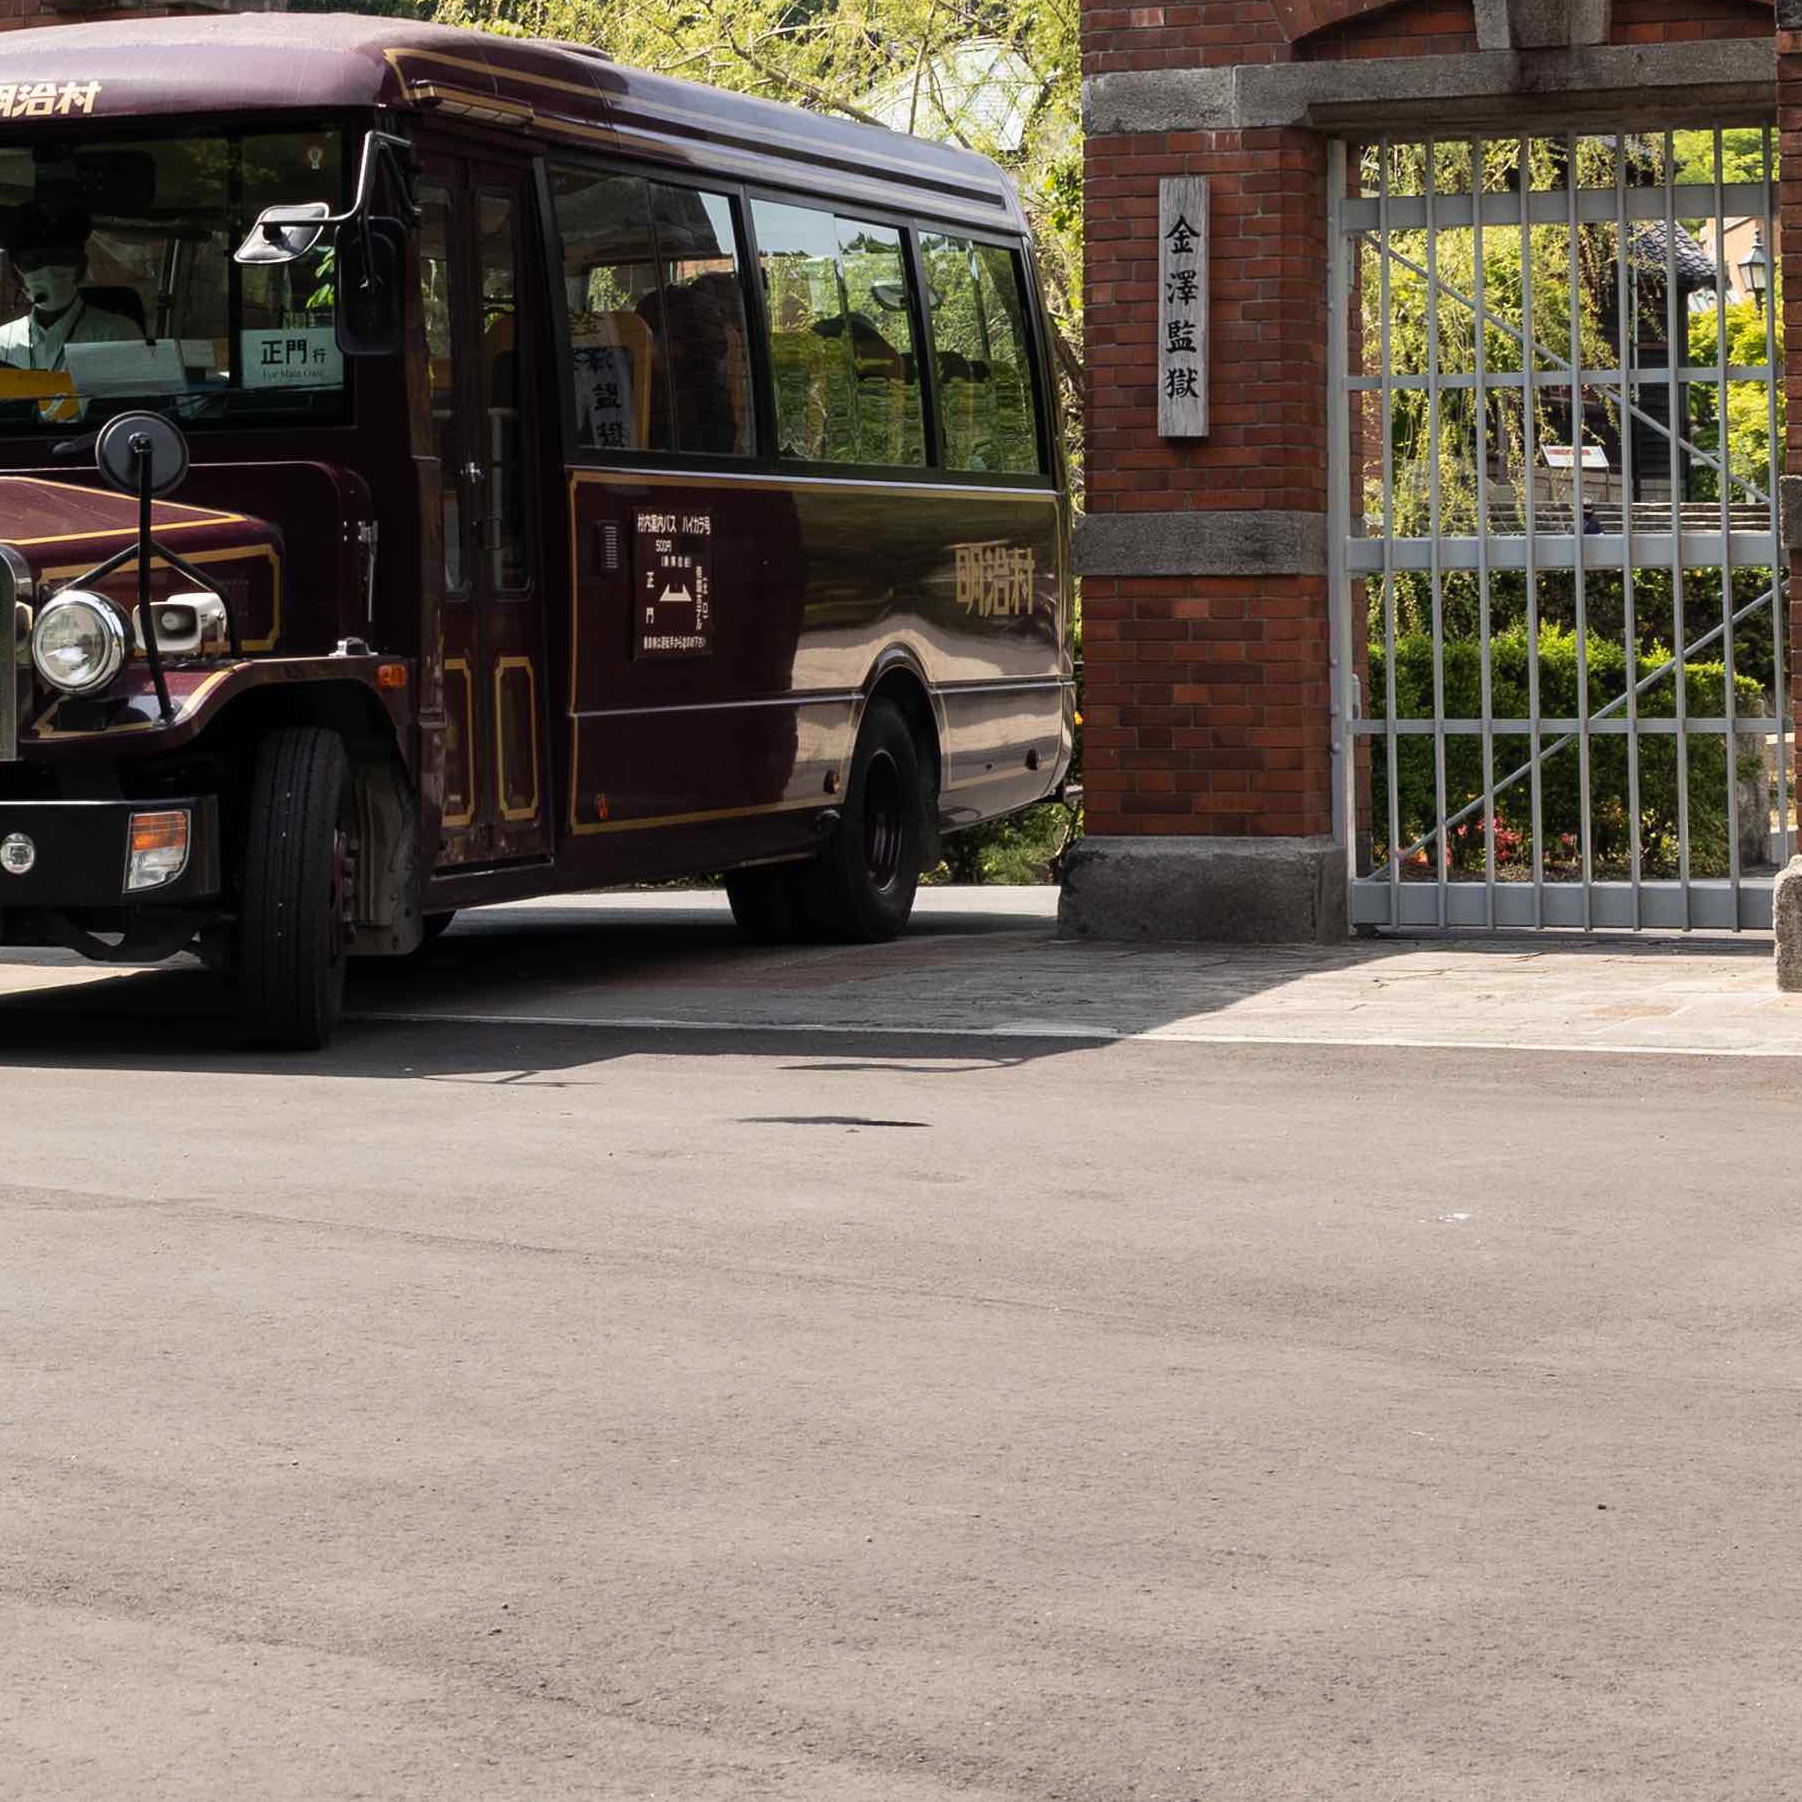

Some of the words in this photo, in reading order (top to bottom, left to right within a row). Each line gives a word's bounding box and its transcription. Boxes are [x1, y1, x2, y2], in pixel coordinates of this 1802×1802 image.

[1164, 214, 1200, 398] 金澤監獄
[956, 548, 1035, 617] 明治村
